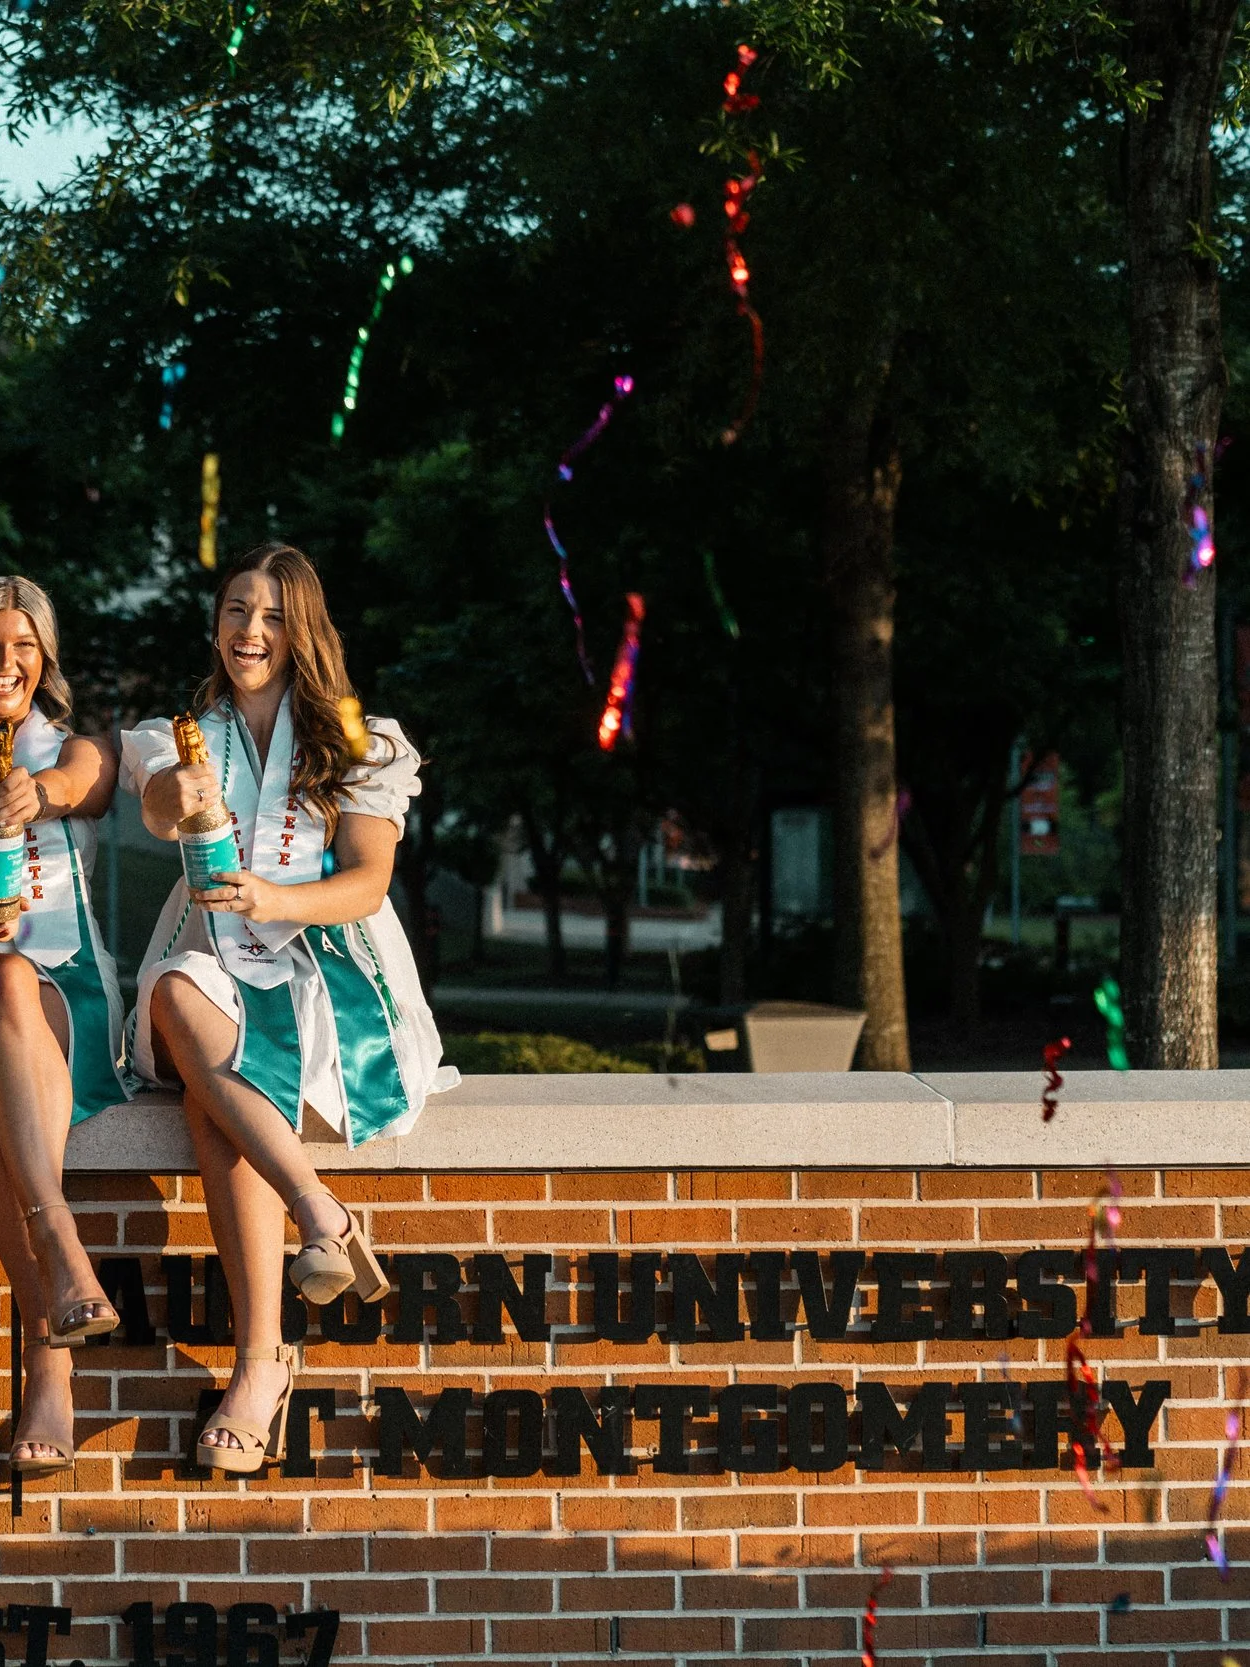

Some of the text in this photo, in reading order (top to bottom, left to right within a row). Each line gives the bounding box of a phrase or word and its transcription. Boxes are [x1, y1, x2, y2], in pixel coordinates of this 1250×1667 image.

[25, 828, 44, 899] LETE
[589, 1247, 1250, 1341] UNIVERSITY
[176, 1380, 1171, 1479] T MONTGOMERY
[121, 1601, 339, 1667] 1967
